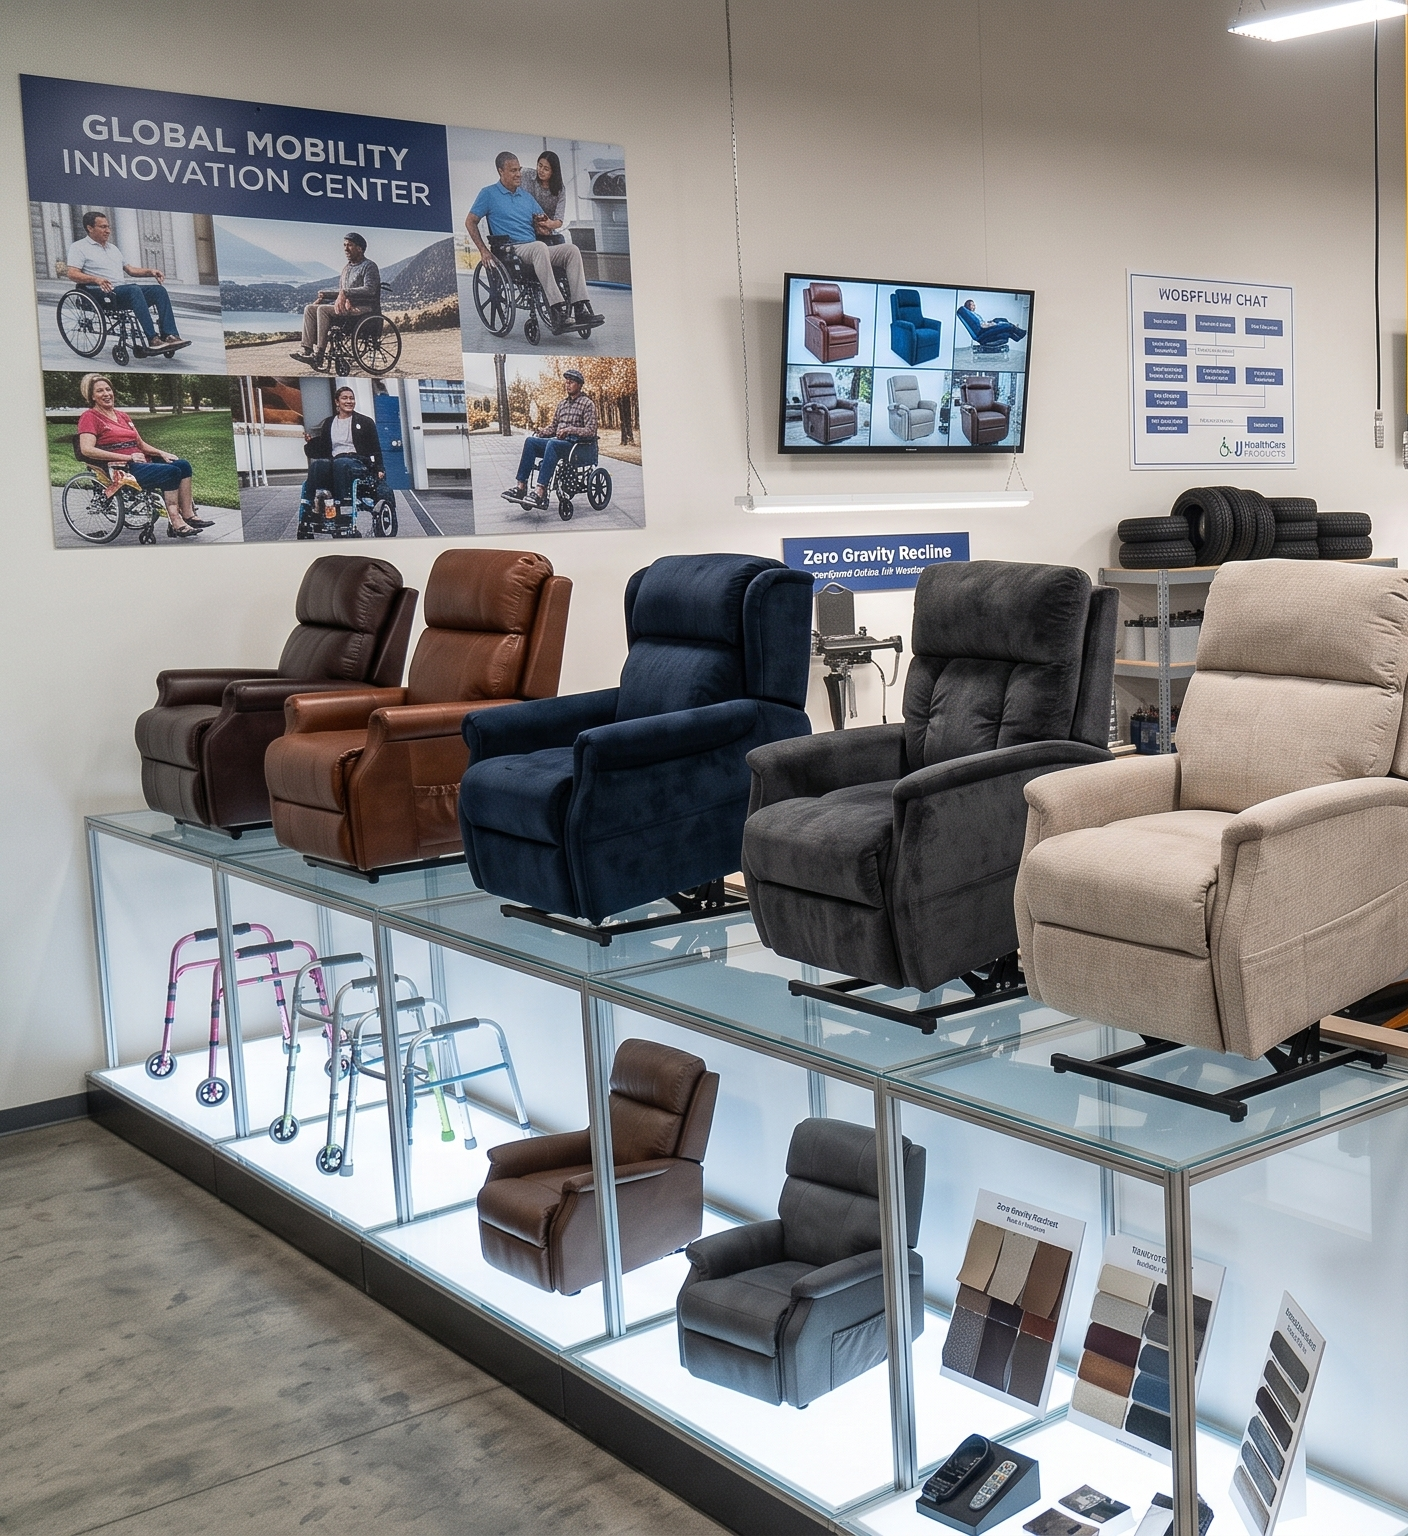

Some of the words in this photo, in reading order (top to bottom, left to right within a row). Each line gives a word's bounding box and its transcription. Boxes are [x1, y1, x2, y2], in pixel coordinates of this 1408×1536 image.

[82, 114, 236, 154] GLOBAL
[247, 130, 409, 171] MOBILITY
[63, 148, 290, 194] INNOVATION
[302, 171, 431, 206] CENTER
[1235, 293, 1269, 308] CHAT
[803, 549, 839, 565] Zero
[842, 546, 896, 564] Gravity
[899, 543, 952, 561] Recline
